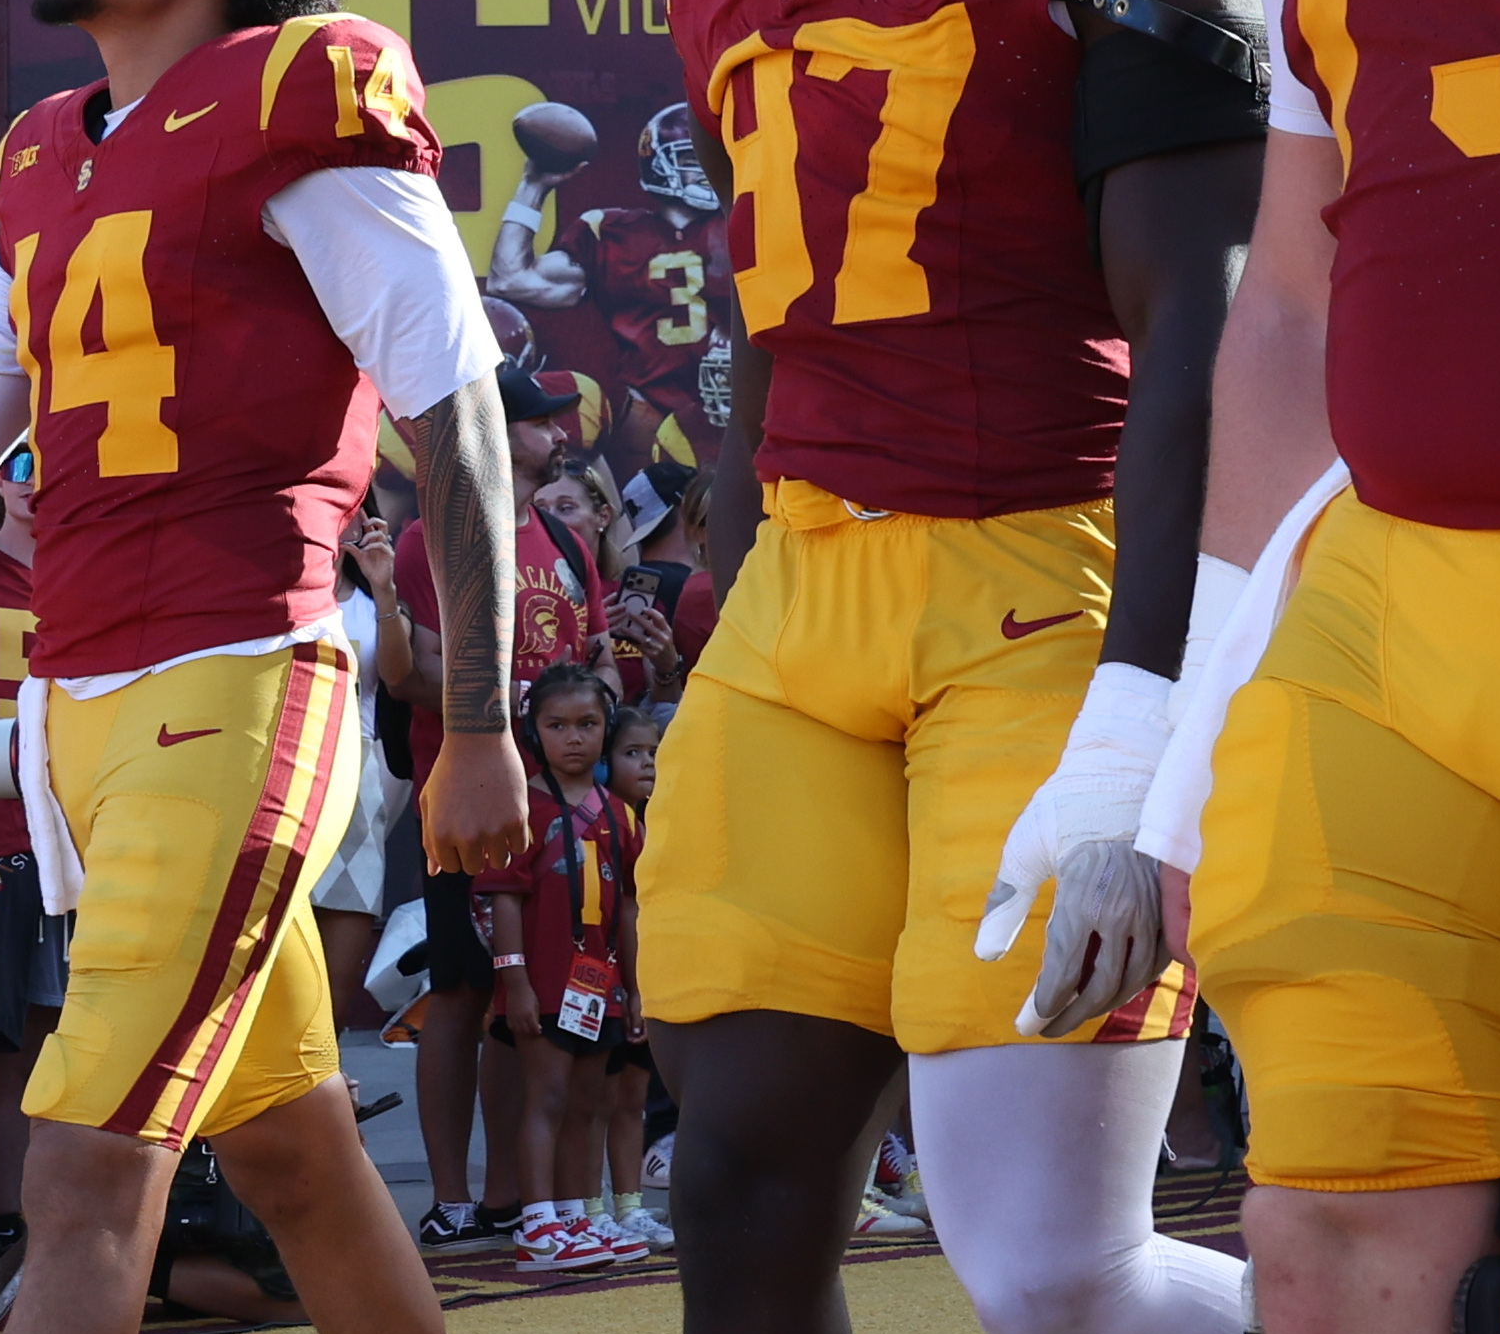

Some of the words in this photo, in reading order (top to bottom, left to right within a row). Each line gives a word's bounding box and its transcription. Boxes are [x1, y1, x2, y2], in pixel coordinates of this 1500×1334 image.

[325, 44, 411, 142] 14
[647, 250, 708, 346] 3
[7, 210, 180, 491] 14
